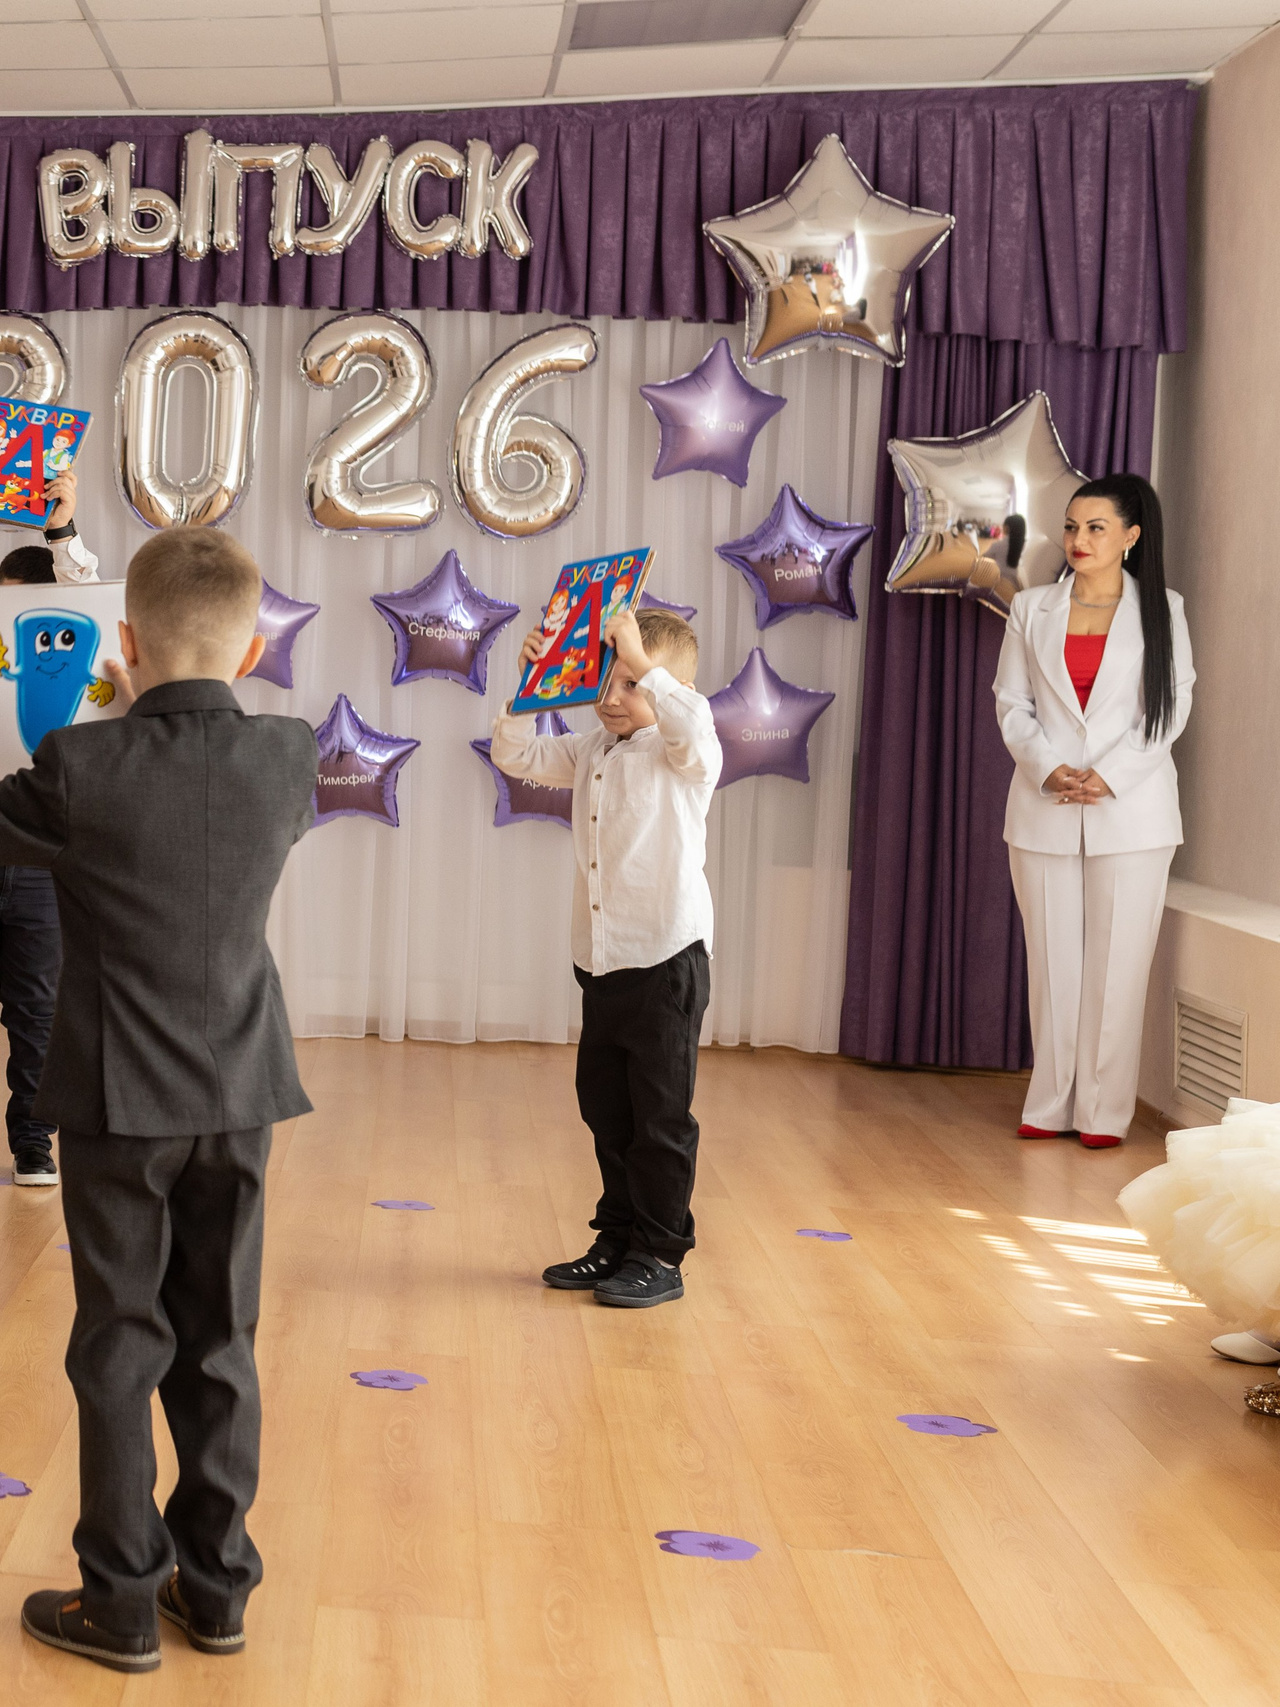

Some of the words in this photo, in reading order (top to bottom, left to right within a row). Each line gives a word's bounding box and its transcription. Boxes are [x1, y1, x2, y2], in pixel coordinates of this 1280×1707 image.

[37, 128, 539, 271] ВЫПУСК
[557, 555, 643, 590] БУКВАРЬ
[774, 565, 822, 582] Роман
[408, 621, 480, 641] Стефания
[520, 580, 604, 698] А
[742, 728, 790, 742] Элина
[317, 772, 375, 787] Тимофей
